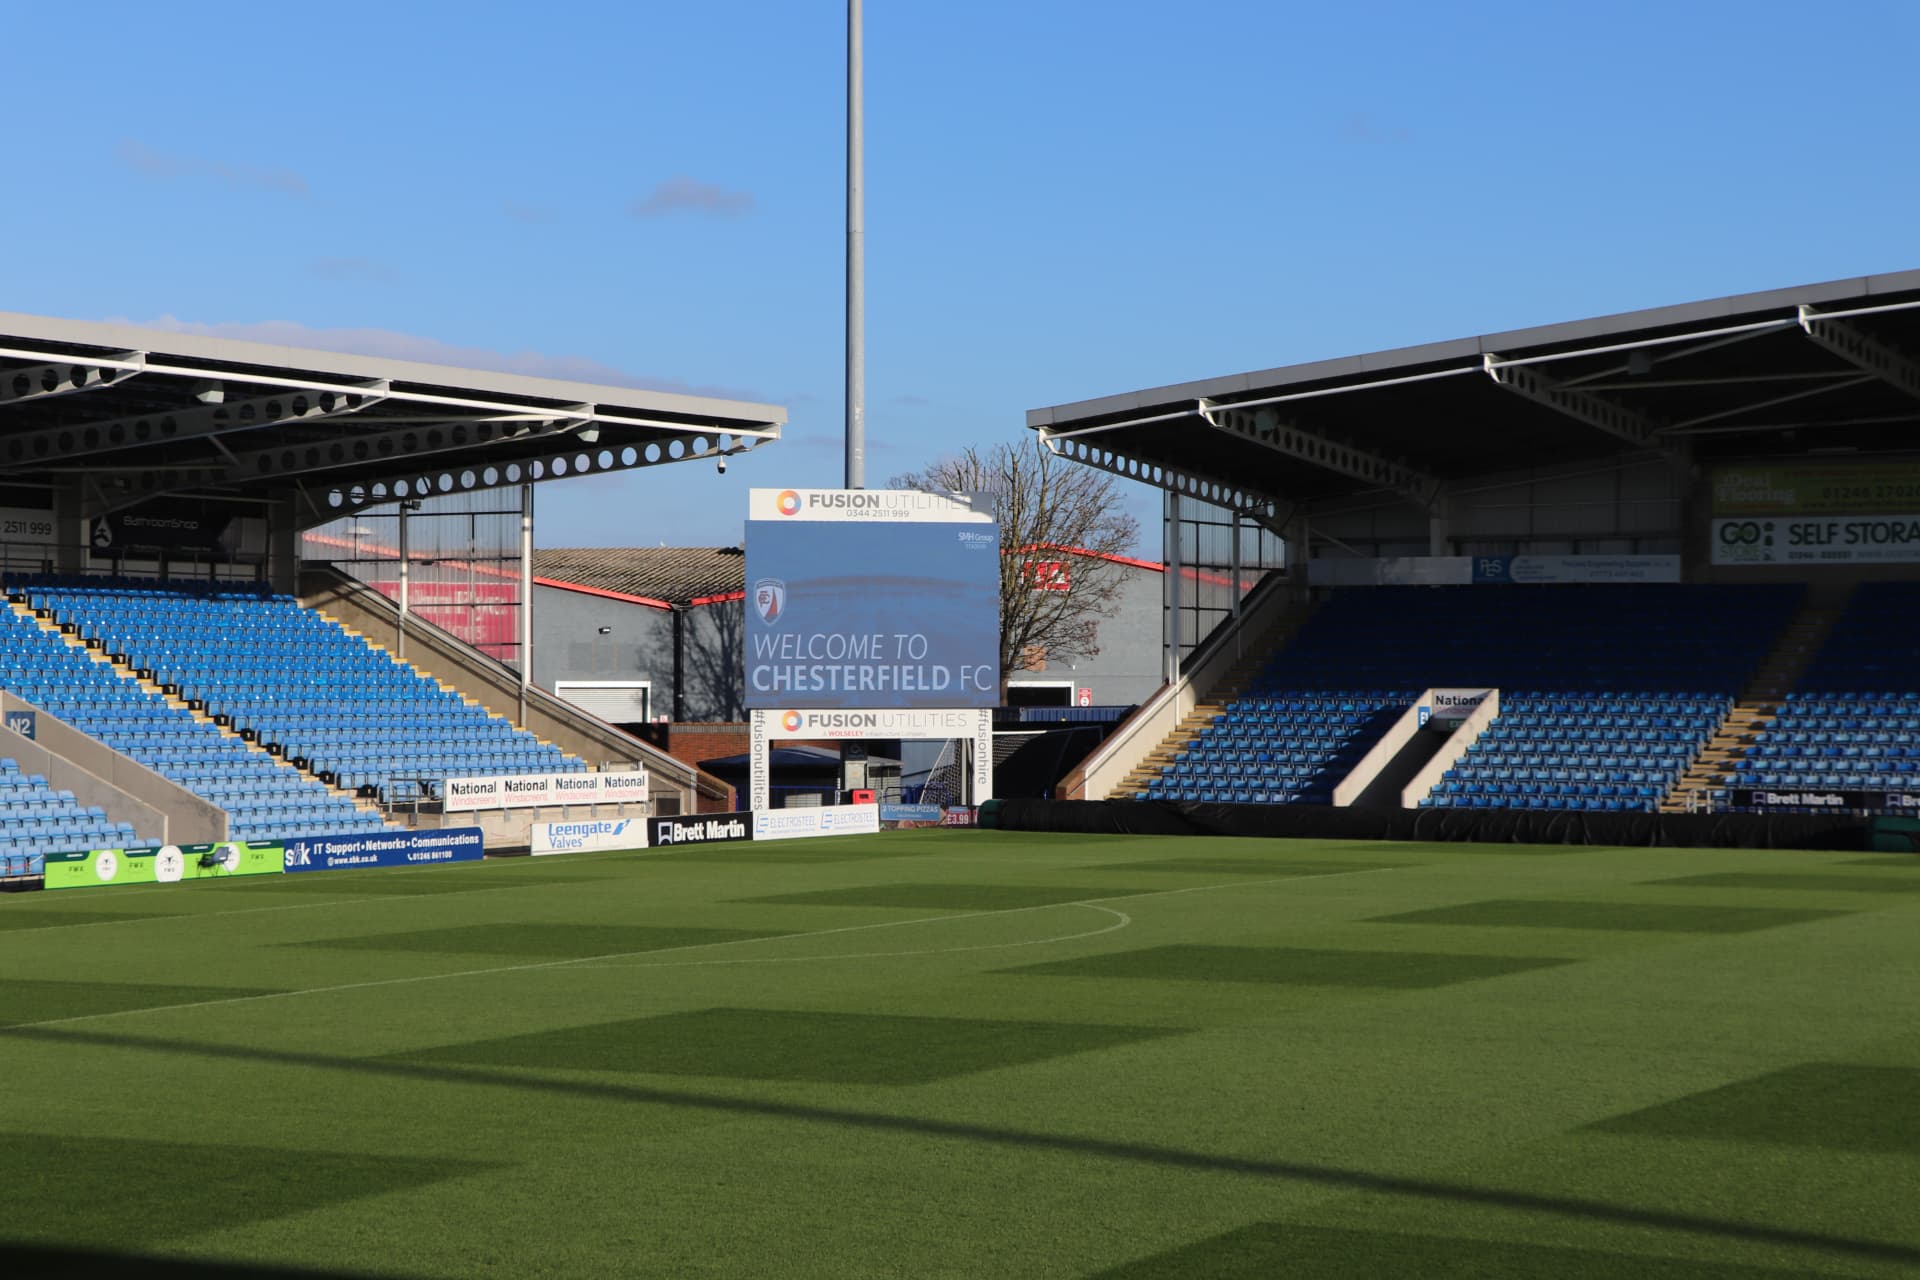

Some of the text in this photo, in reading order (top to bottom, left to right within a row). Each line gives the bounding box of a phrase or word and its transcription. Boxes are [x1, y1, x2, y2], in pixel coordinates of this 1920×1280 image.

[809, 494, 880, 509] FUSION
[846, 509, 910, 518] 0344 2511 999
[4, 521, 52, 535] 2511 999
[1720, 522, 1761, 545] GO
[1788, 523, 1840, 545] SELF
[975, 533, 994, 543] Group
[753, 633, 928, 660] WELCOME TO
[752, 664, 993, 691] CHESTERFIELD FC
[10, 718, 31, 734] N2
[808, 713, 968, 728] FUSION UTILITIES
[978, 709, 990, 785] #fusionhire
[754, 709, 766, 810] #fusionutilities
[451, 781, 497, 796] National
[504, 779, 548, 793] National
[555, 777, 598, 791] National
[604, 775, 645, 789] National
[1767, 793, 1844, 806] Brett Martin
[916, 805, 938, 813] PIZZAS
[947, 813, 969, 825] £3.99
[548, 821, 612, 839] Leengate
[673, 820, 745, 843] Brett Martin
[313, 835, 479, 856] IT Support Networks Communications
[549, 836, 584, 848] Valves
